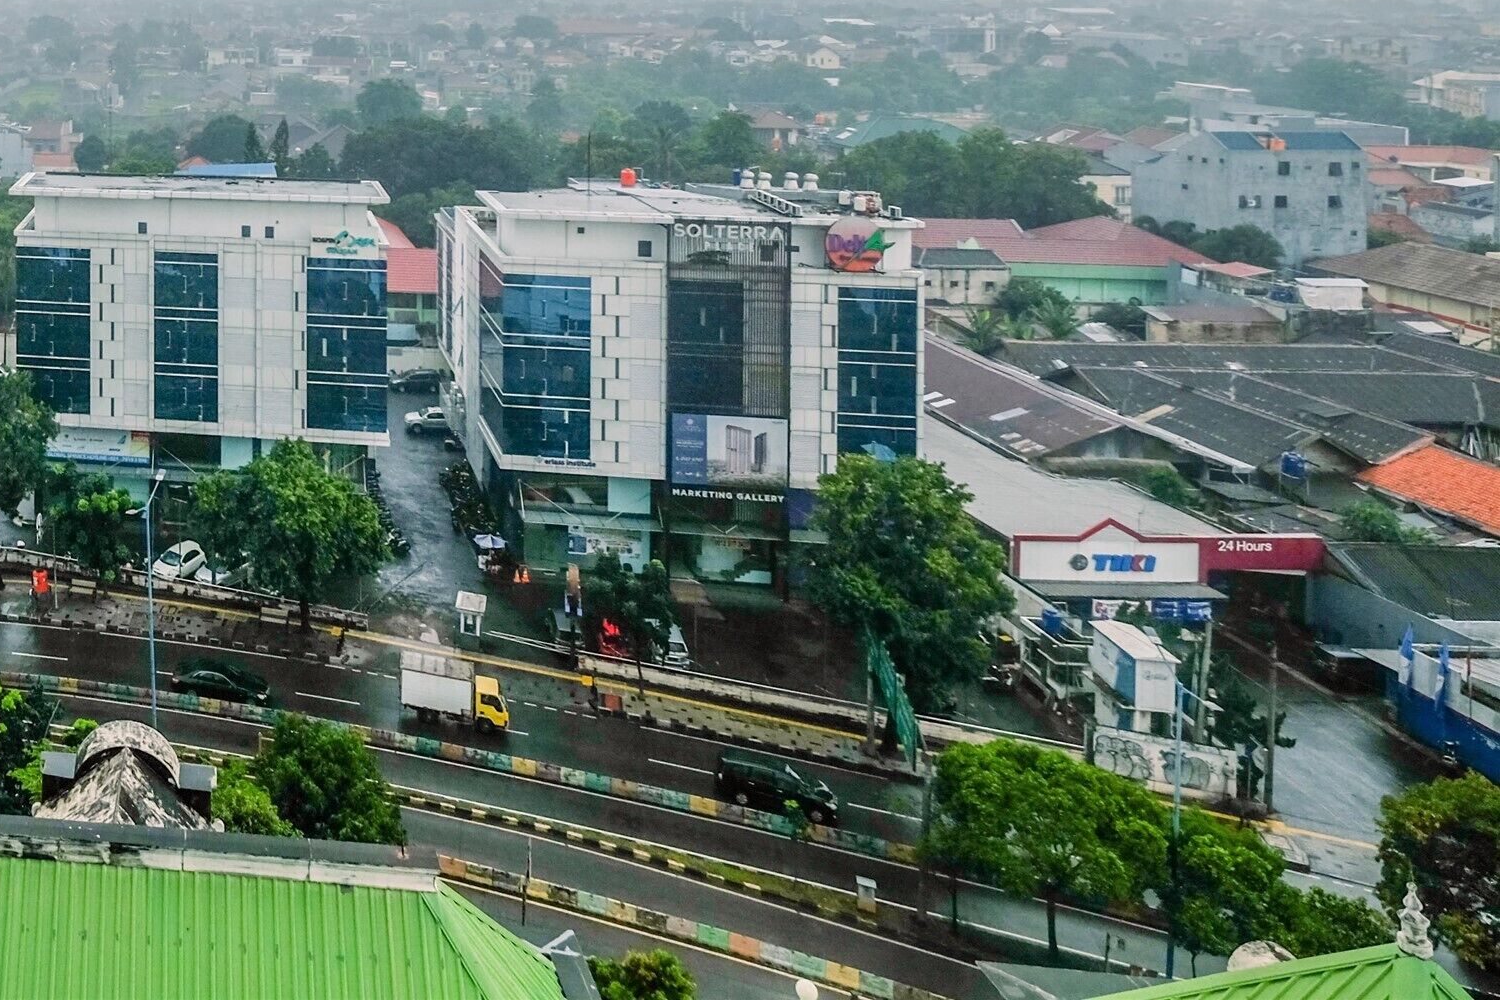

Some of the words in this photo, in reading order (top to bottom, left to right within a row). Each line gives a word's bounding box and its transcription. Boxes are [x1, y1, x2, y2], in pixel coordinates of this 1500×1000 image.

[673, 223, 784, 241] SOLTERRA
[672, 488, 733, 500] MARKETING
[736, 493, 785, 503] GALLERY
[1218, 540, 1234, 552] 24
[1236, 540, 1273, 552] Hours
